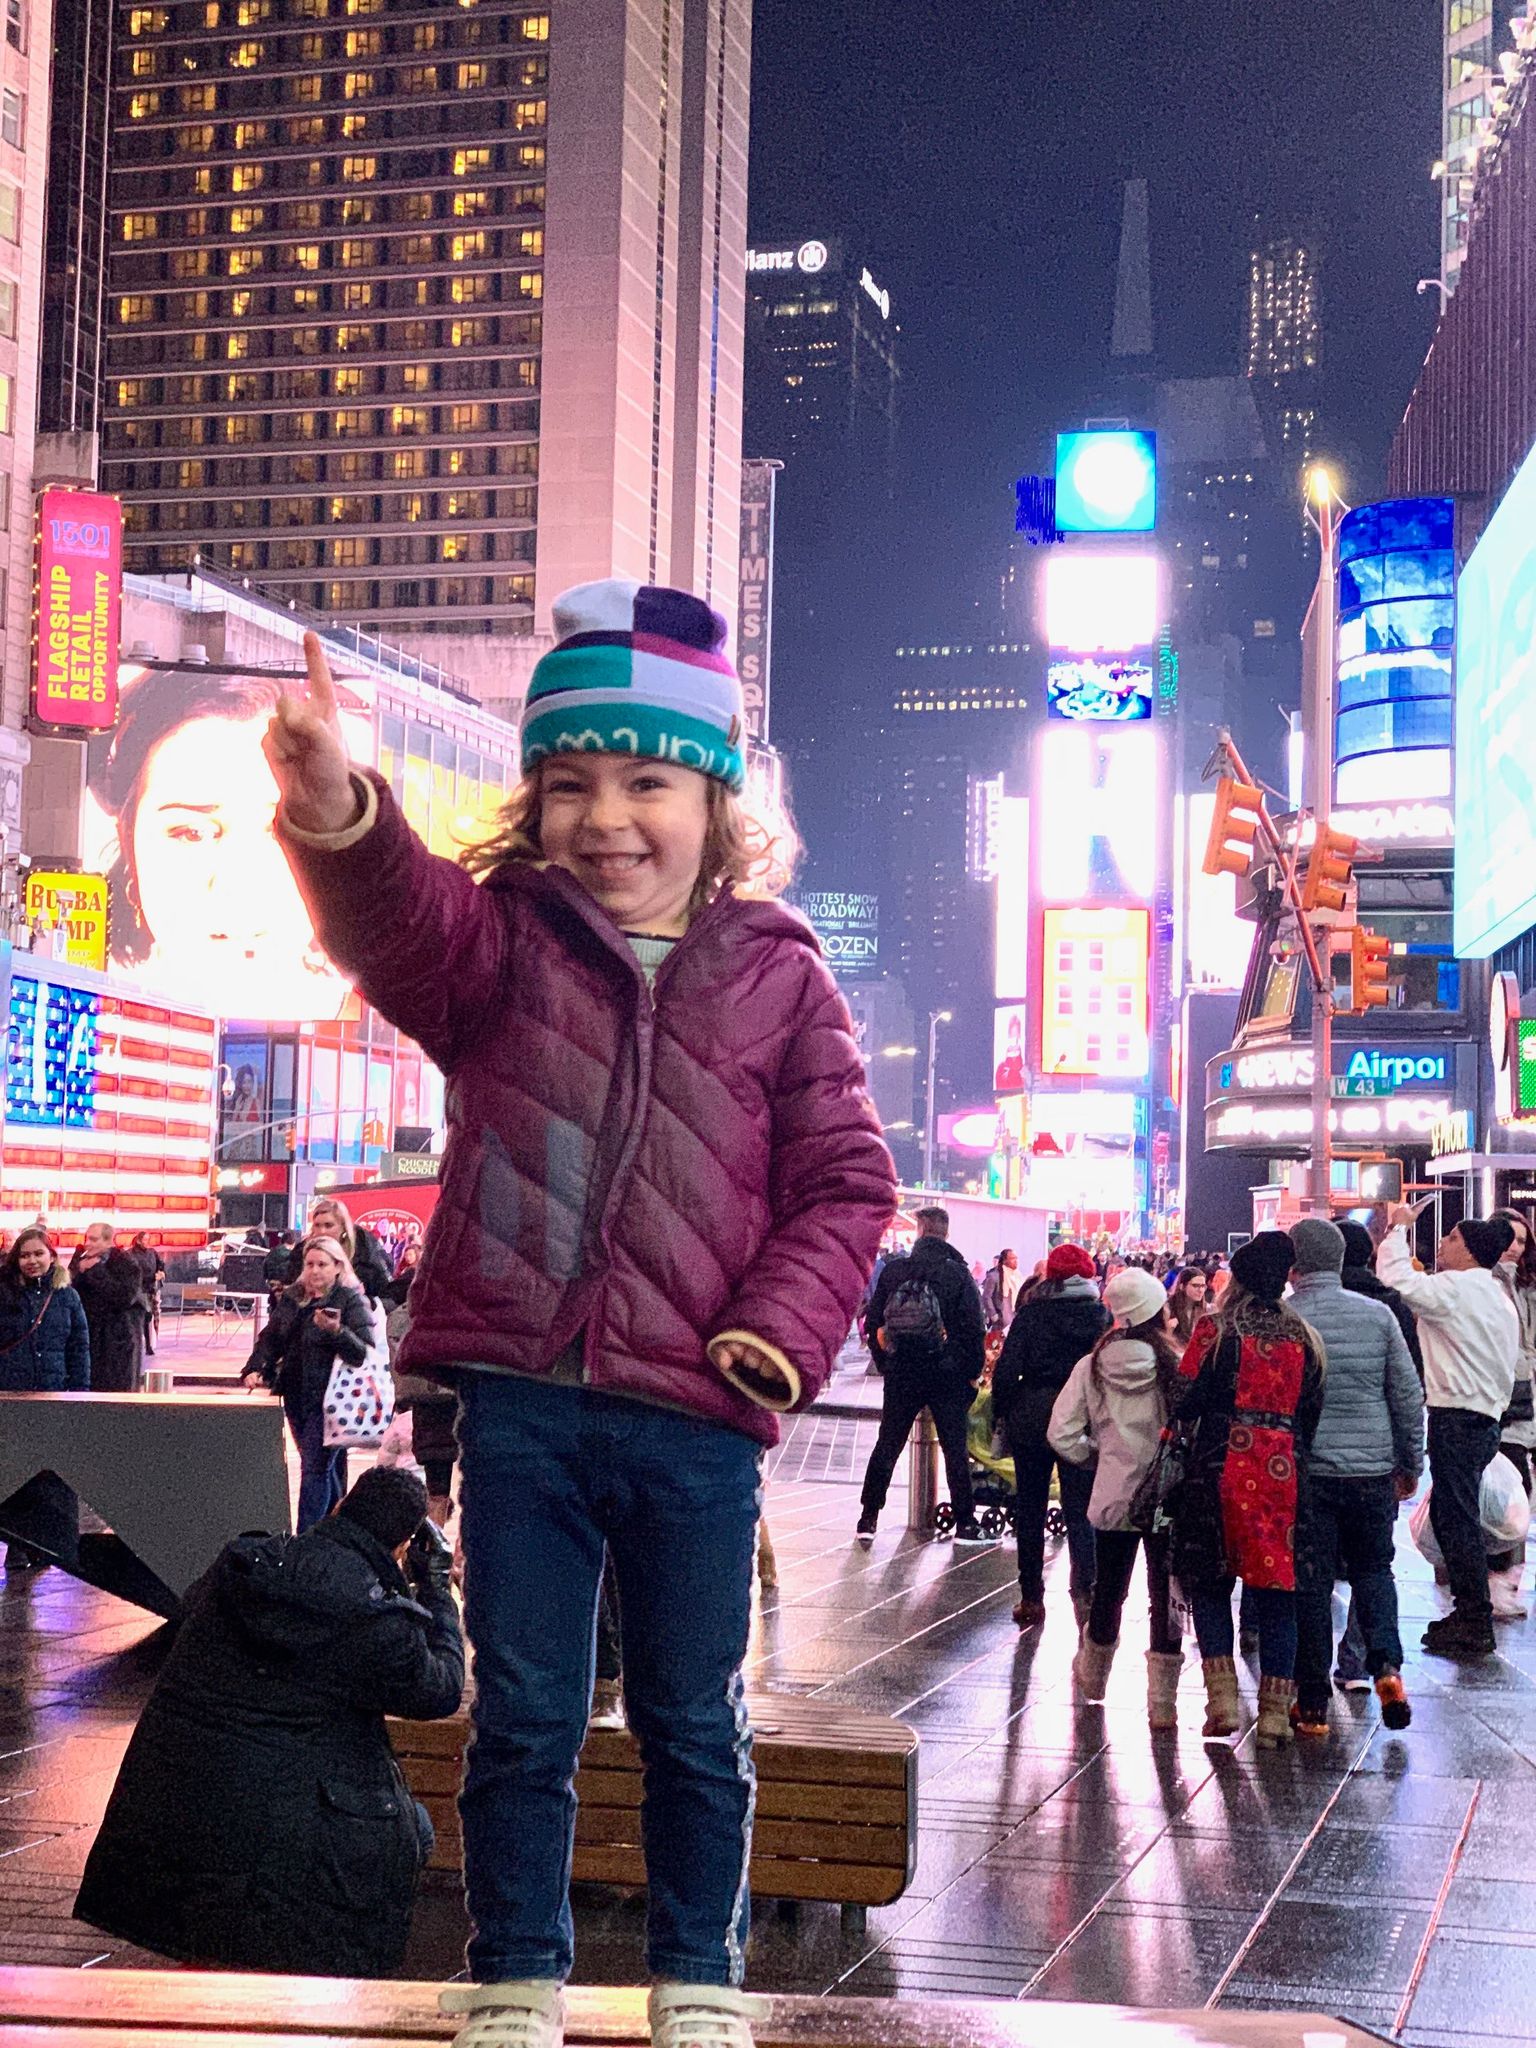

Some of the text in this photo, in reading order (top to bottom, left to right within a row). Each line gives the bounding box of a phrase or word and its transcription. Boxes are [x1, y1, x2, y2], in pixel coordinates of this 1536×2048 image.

[50, 520, 110, 547] 1501
[741, 502, 766, 638] TIMES
[48, 565, 71, 699] FLAGSHIP
[92, 571, 109, 703] OPPORTUNITY
[70, 610, 92, 701] RETAIL
[801, 893, 845, 904] HOTTEST
[802, 904, 878, 919] BROADWAY!
[817, 935, 878, 958] ROZEN
[1337, 1078, 1349, 1095] W
[1355, 1079, 1375, 1095] 43
